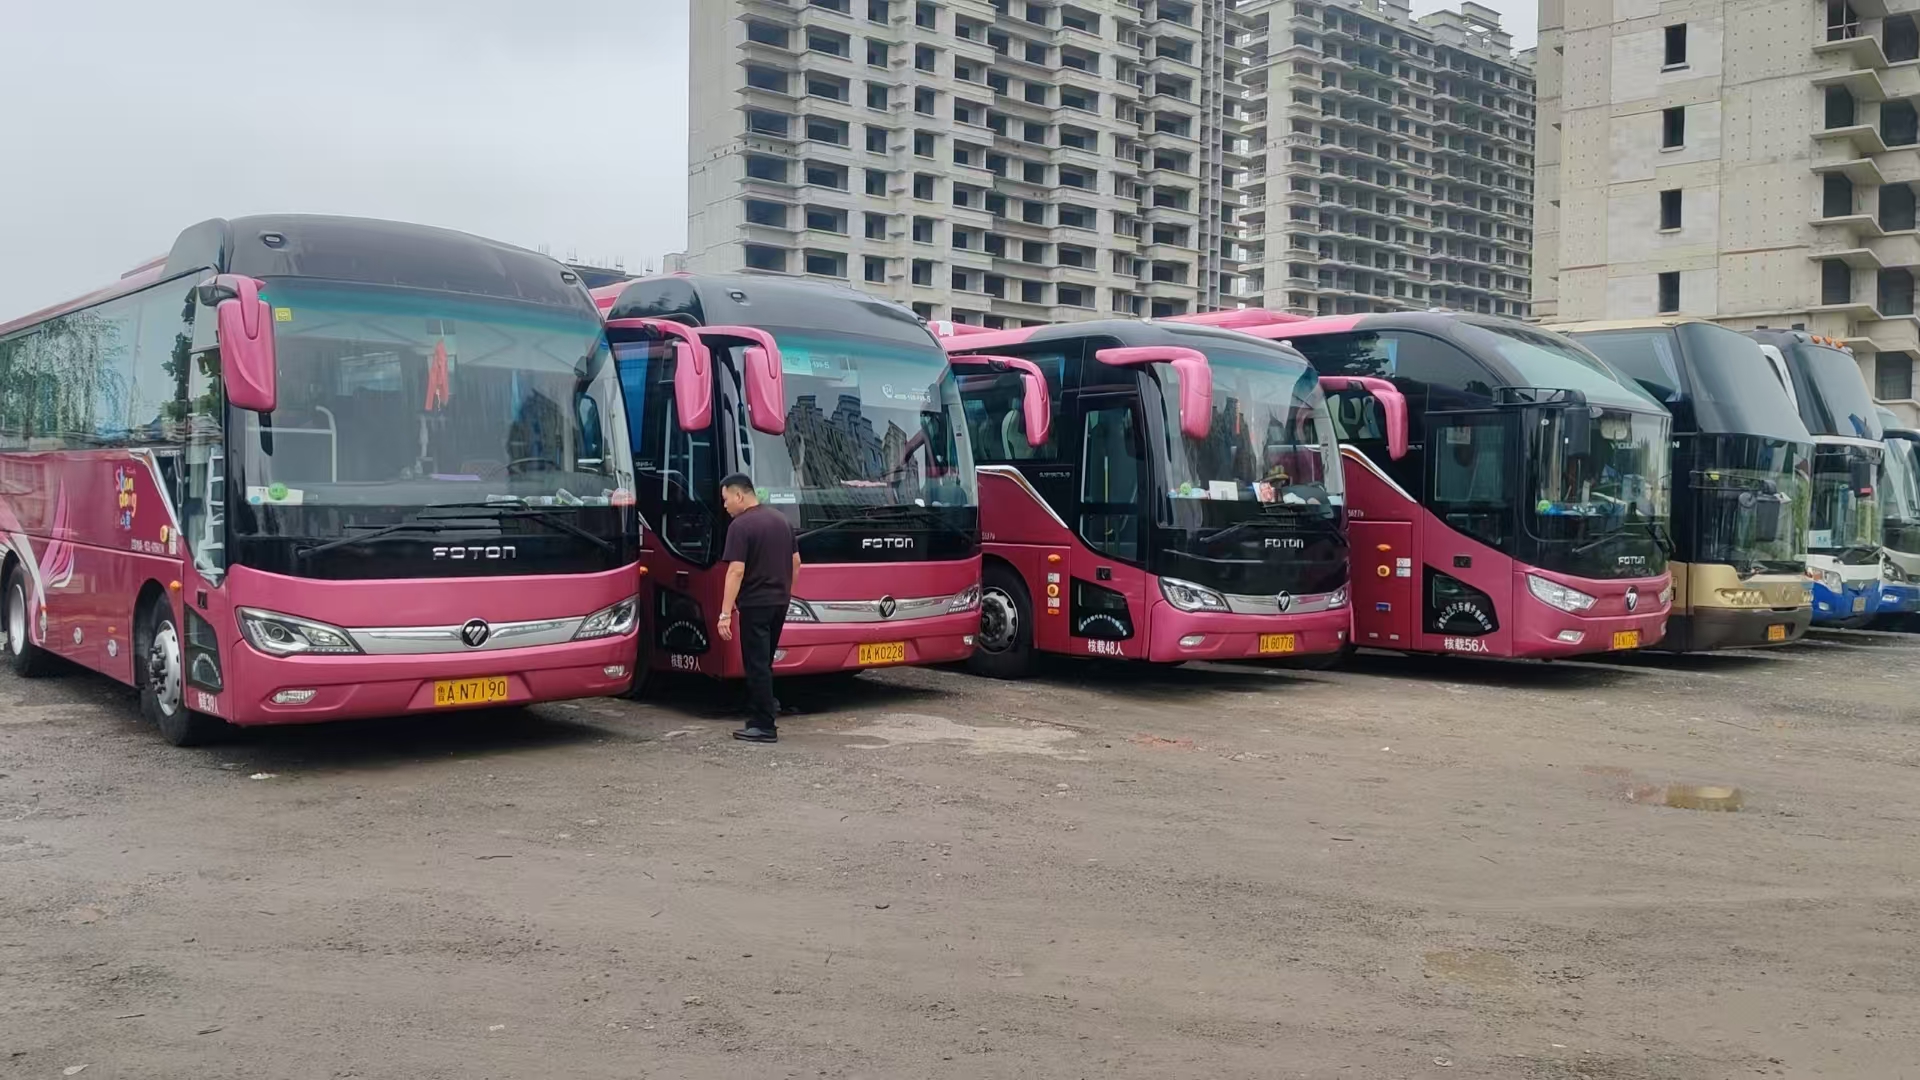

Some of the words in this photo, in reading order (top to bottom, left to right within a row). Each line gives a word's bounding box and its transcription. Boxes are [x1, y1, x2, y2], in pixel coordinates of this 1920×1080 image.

[862, 537, 914, 549] FOTON
[1263, 538, 1304, 549] FOTON
[432, 546, 516, 560] FOTON
[1087, 638, 1124, 656] 核载48人
[1444, 637, 1489, 653] 核载56人
